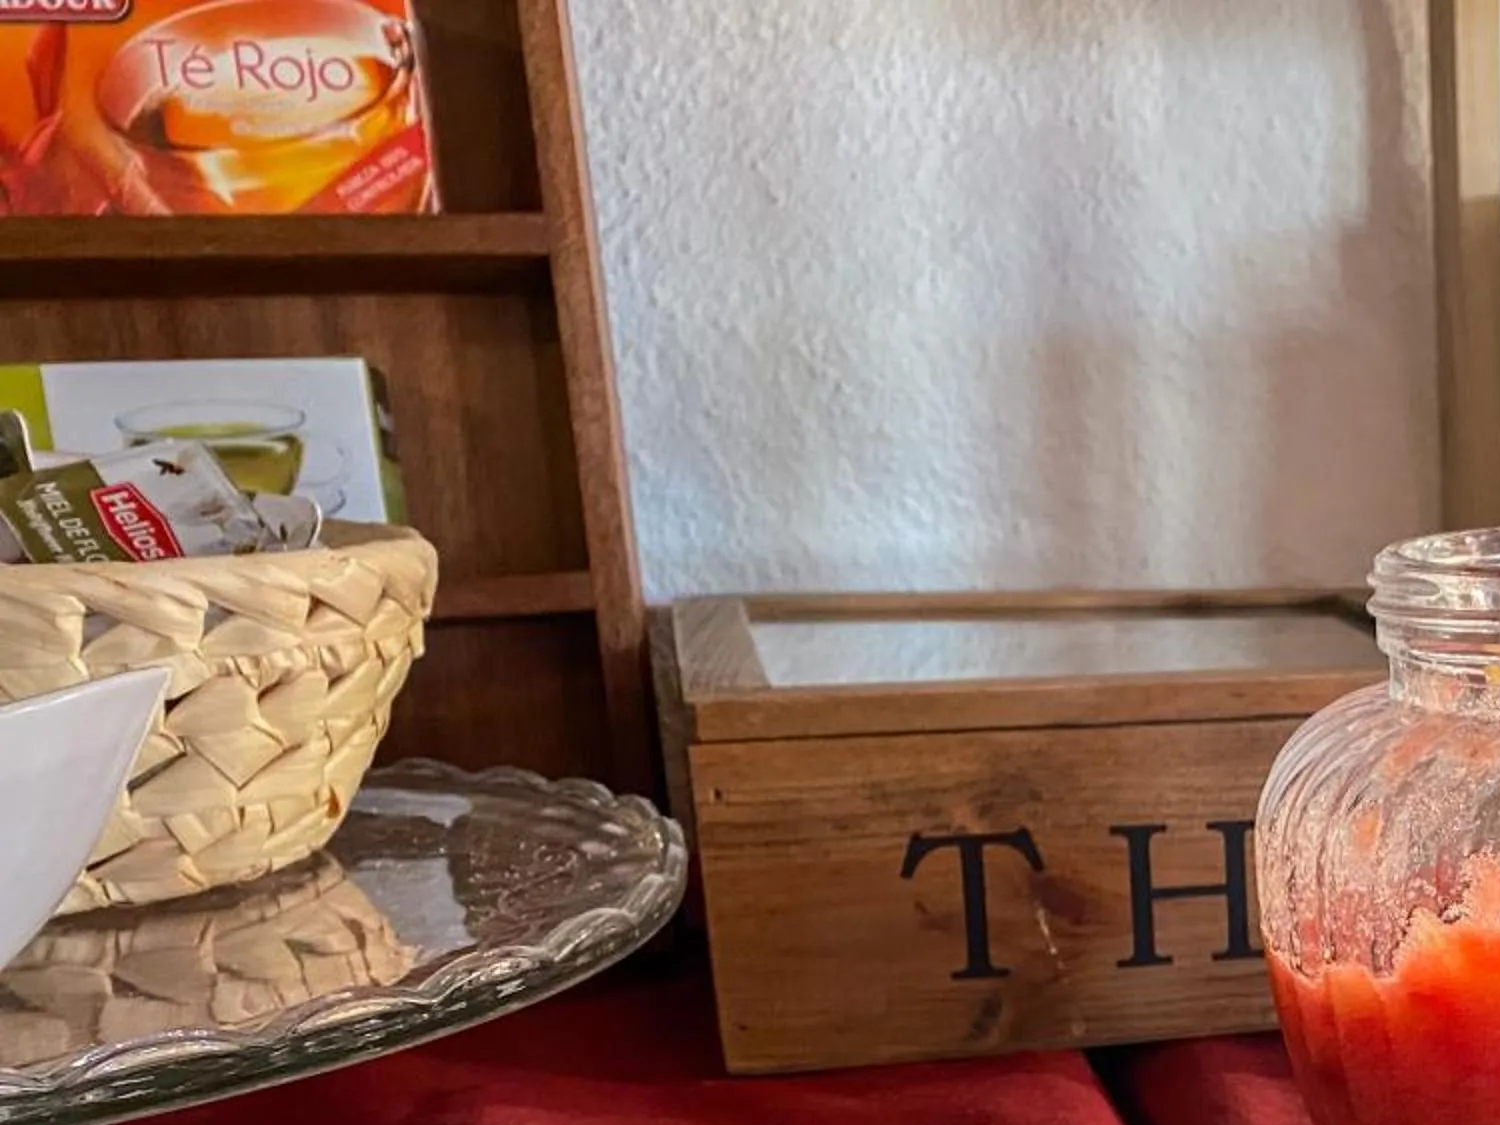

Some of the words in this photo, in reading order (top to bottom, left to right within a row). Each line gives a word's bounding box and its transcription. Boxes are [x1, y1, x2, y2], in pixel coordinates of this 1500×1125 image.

[146, 38, 215, 90] Té
[234, 40, 354, 101] Rojo
[35, 482, 73, 518] MIEL
[59, 517, 91, 539] DE
[101, 489, 166, 562] Helios
